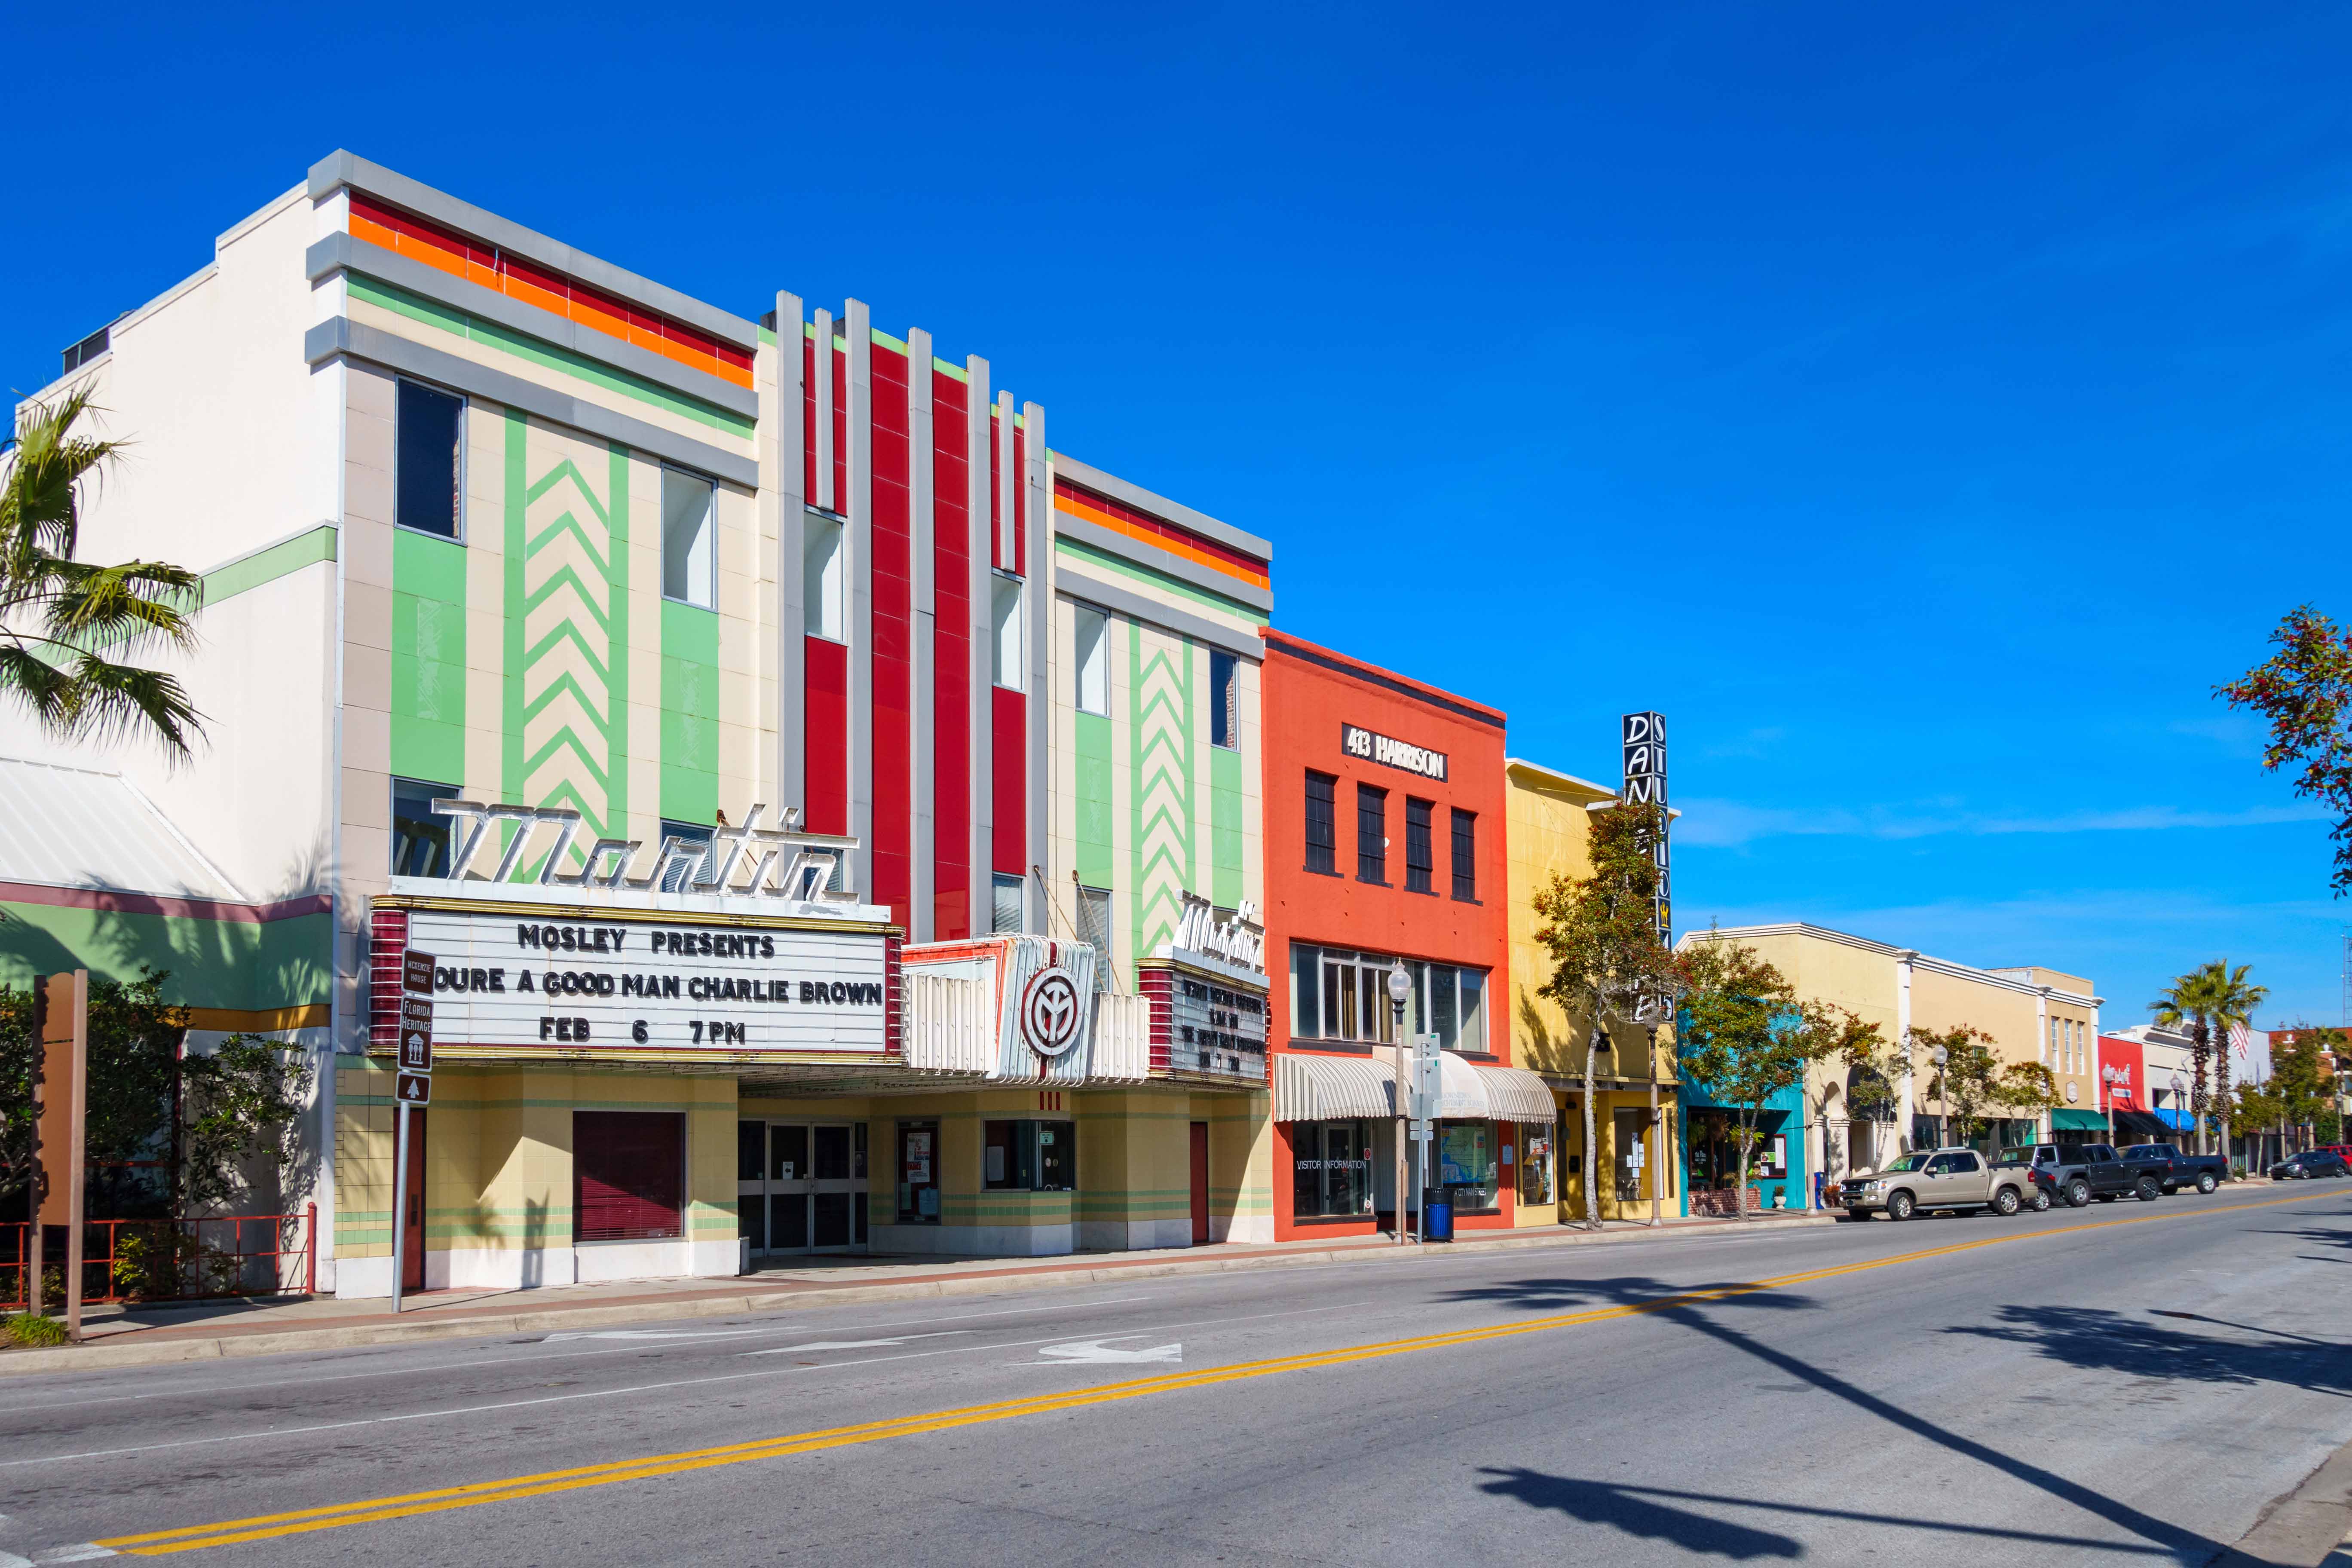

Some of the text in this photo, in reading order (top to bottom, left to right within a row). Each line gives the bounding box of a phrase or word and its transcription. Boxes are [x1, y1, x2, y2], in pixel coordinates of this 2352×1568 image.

[1348, 728, 1443, 778] 413 HARRISON
[1654, 716, 1669, 897] STUDIO
[432, 798, 861, 904] Martin
[518, 924, 775, 957] MOSLEY PRESENTS
[407, 960, 431, 973] MCKENZIE
[410, 973, 427, 984] HOUSE
[434, 966, 882, 1004] OURE A GOOD MAN CHARLIE BROWN
[404, 1000, 430, 1017] FLORIDA
[402, 1016, 431, 1032] HERITAGE
[540, 1017, 590, 1041] FEB
[632, 1020, 648, 1042] 6
[1297, 1160, 1366, 1169] VISITOR INFORMATION
